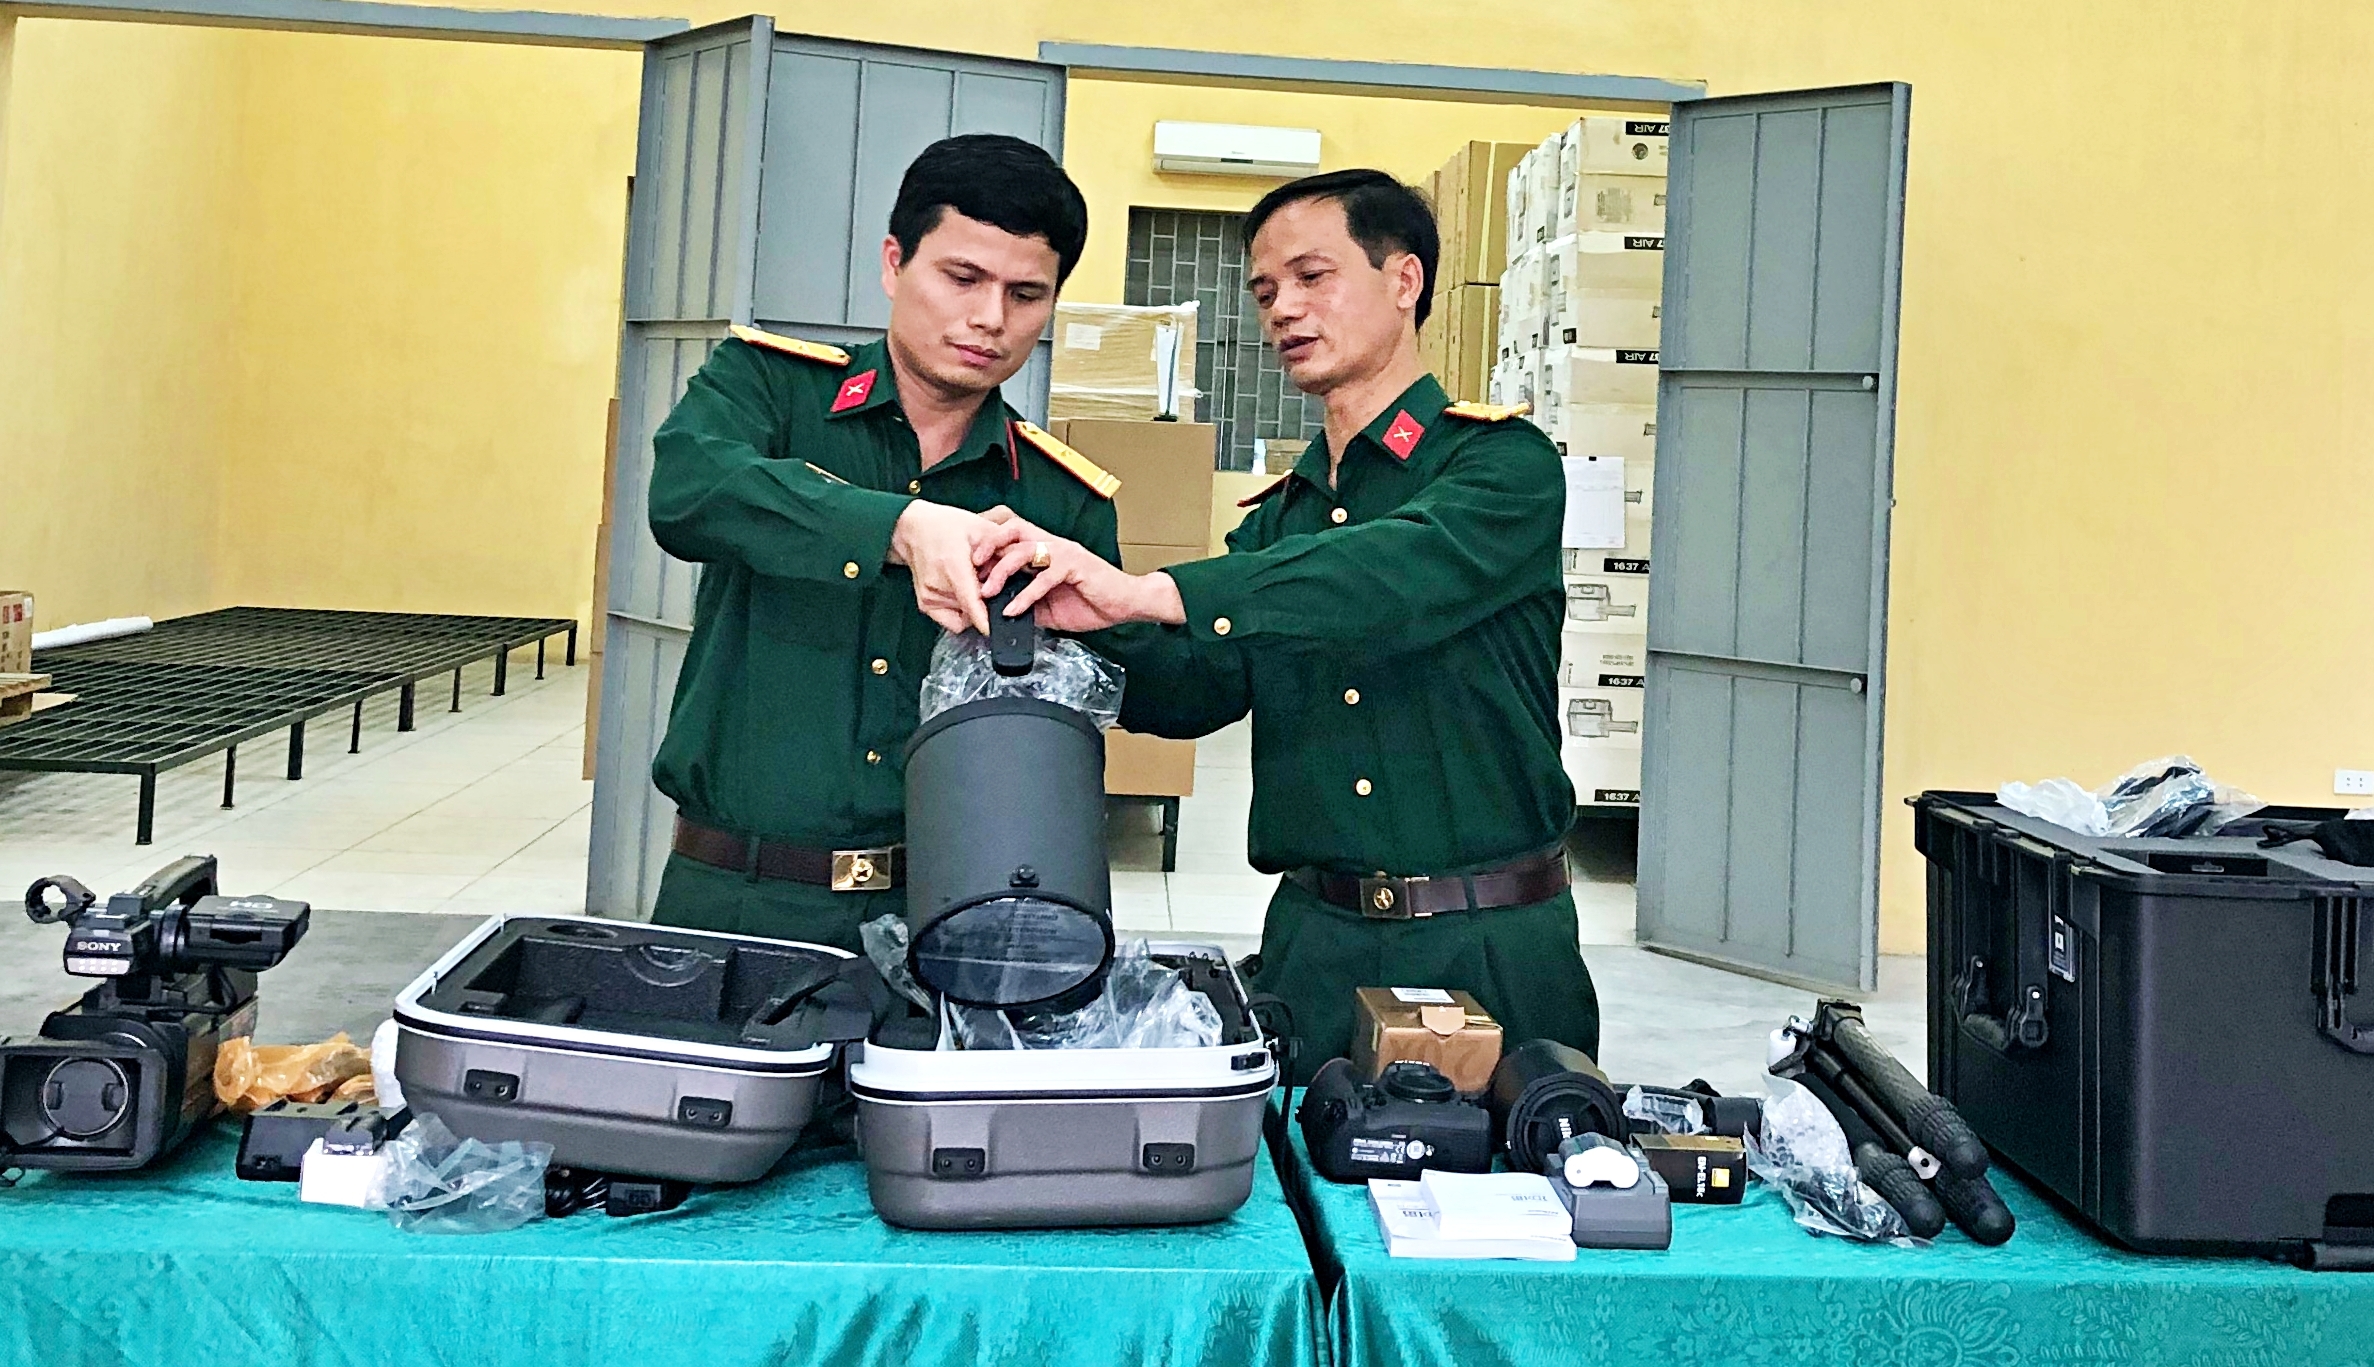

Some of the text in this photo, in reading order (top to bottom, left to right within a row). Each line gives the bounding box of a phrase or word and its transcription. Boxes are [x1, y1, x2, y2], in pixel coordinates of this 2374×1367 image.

[1634, 124, 1656, 133] AIR
[1632, 238, 1655, 248] AIR
[1624, 352, 1647, 362] AIR
[1613, 561, 1650, 572] 1637 A
[1608, 676, 1645, 687] 1637 A
[1631, 793, 1640, 802] A
[76, 941, 122, 953] SONY
